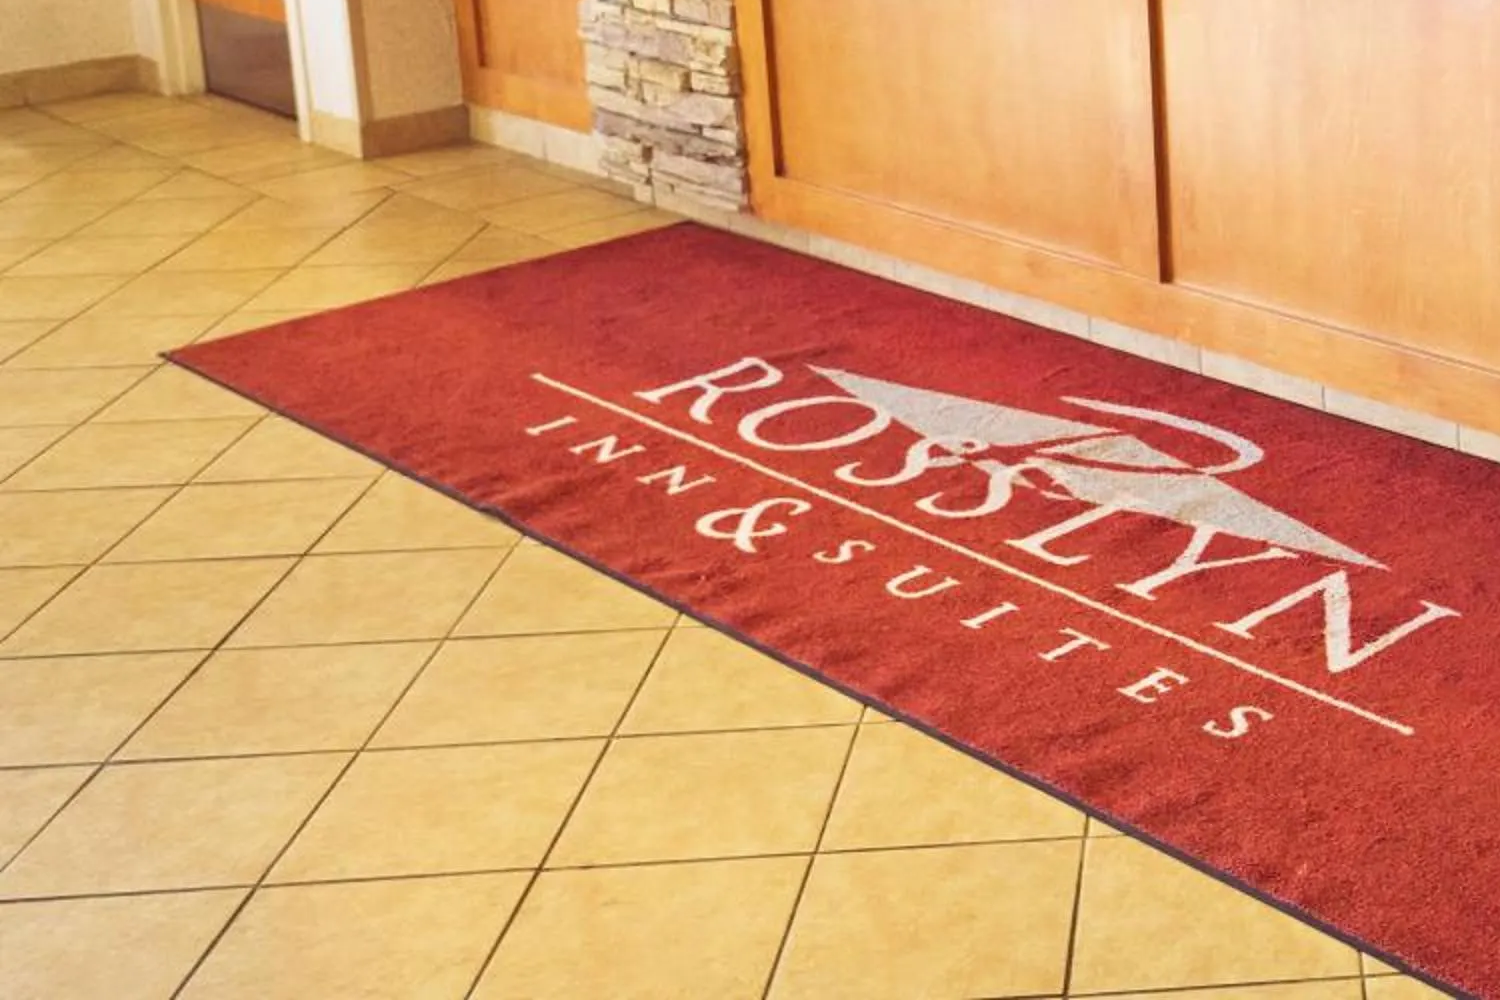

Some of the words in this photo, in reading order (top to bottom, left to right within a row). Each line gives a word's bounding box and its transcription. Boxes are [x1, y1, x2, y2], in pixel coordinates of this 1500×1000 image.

[525, 413, 716, 499] INN
[693, 495, 812, 555] &
[812, 537, 1274, 741] SUITES
[632, 355, 1462, 674] ROSSLYN
